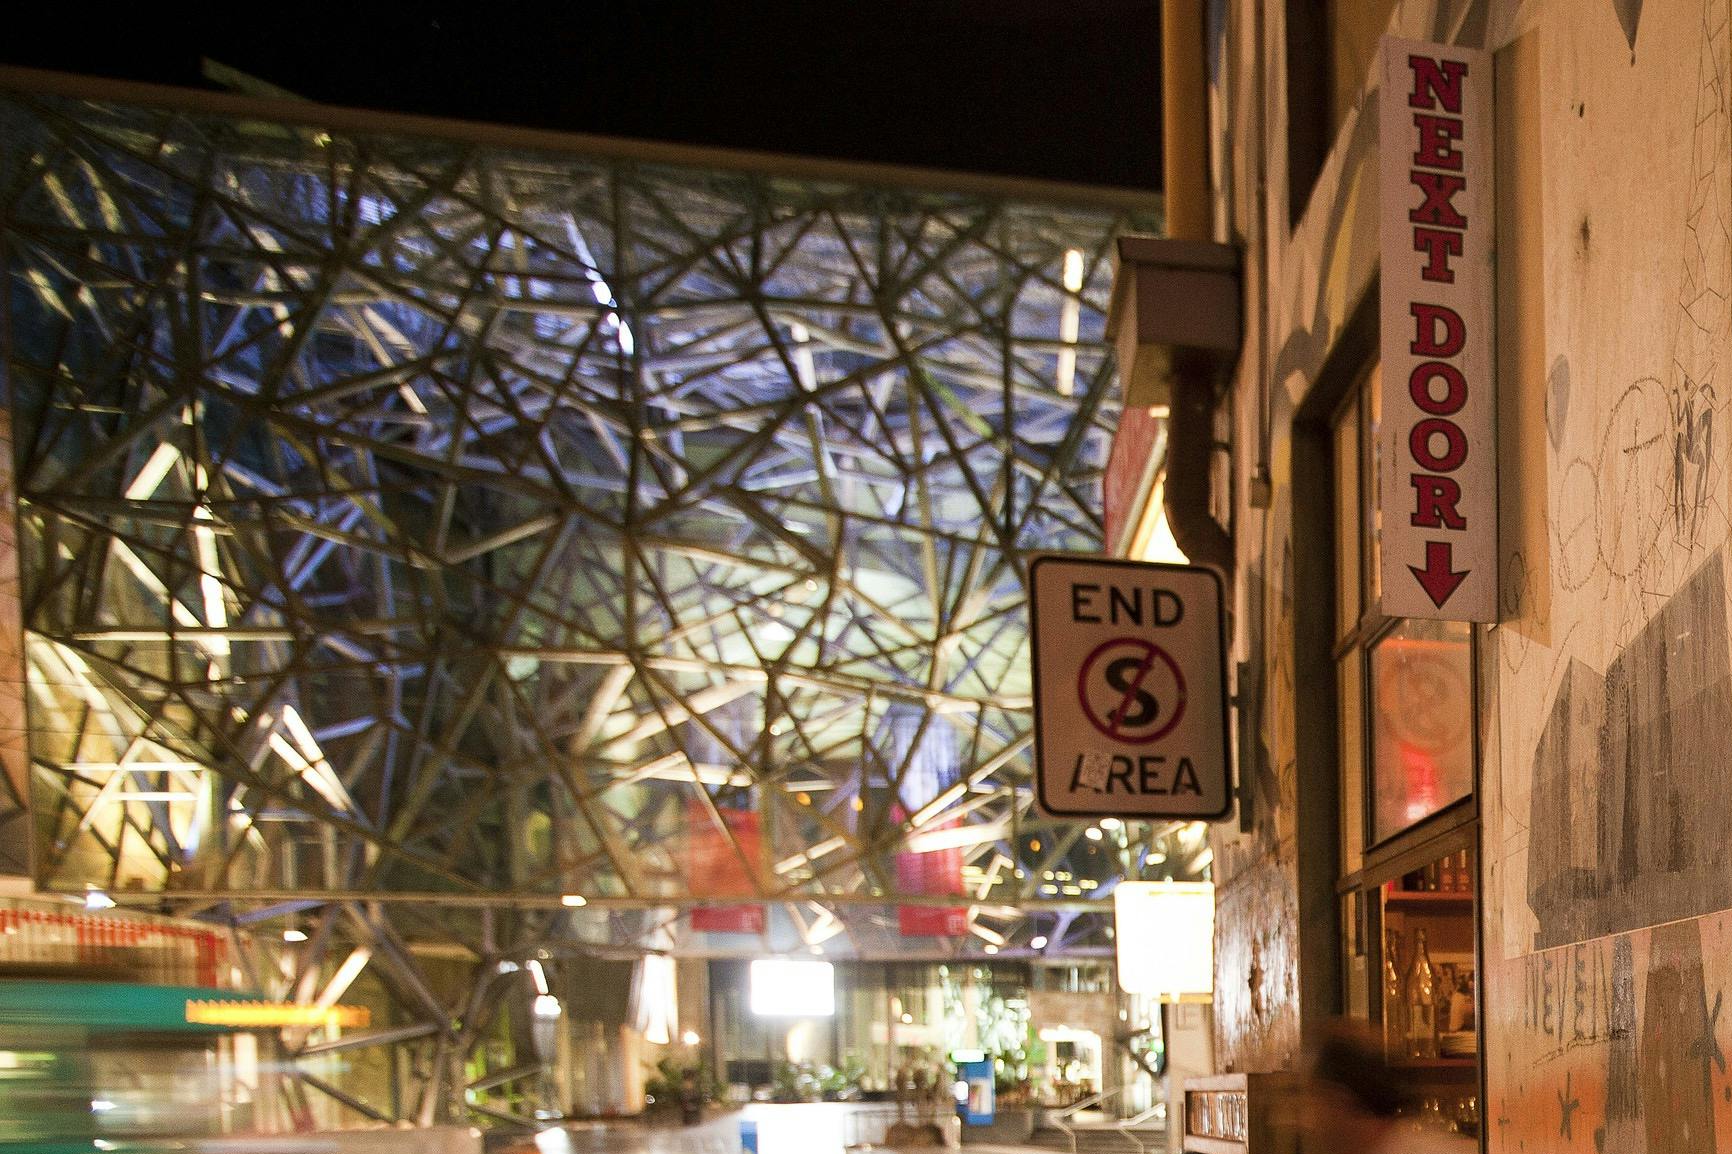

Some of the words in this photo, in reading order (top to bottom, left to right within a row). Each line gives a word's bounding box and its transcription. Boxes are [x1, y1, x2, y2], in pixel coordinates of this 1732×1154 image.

[1408, 55, 1468, 285] NEXT
[1408, 302, 1468, 531] DOOR
[1071, 583, 1184, 627] END
